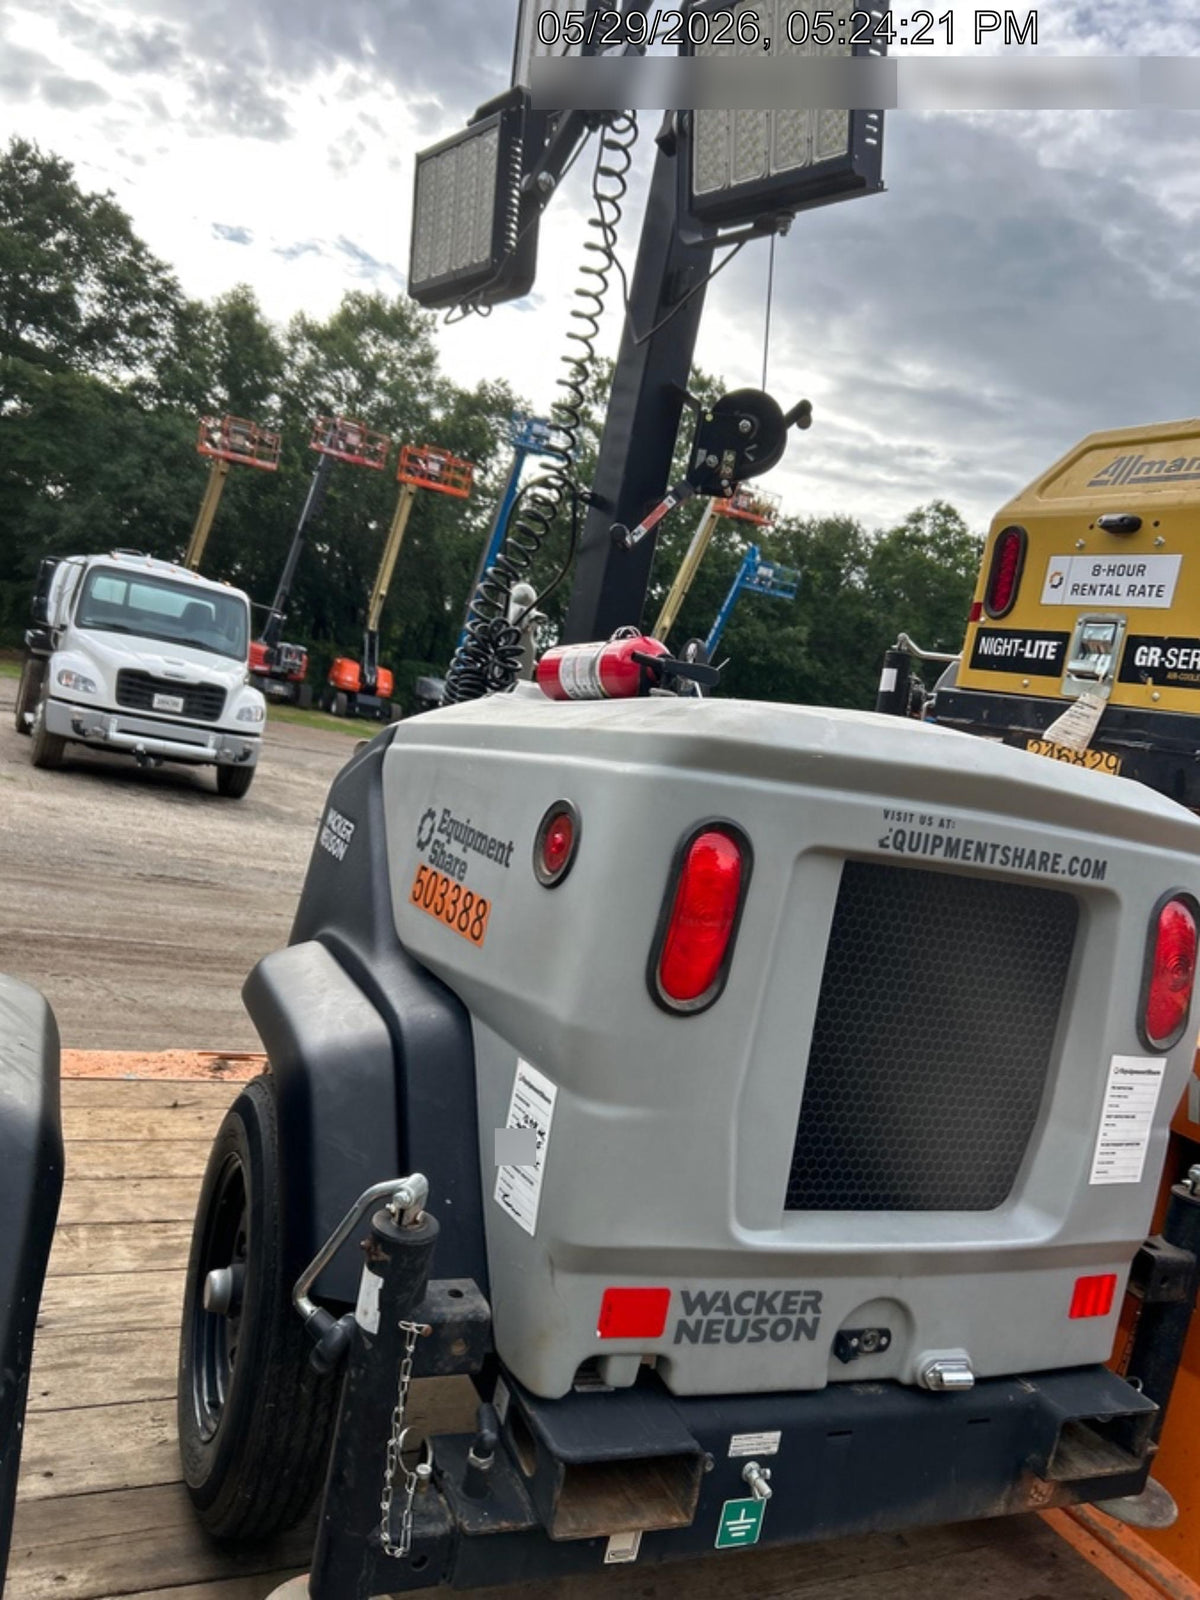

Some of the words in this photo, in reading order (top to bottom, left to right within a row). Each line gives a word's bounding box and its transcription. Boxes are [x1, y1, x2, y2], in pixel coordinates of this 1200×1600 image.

[1091, 563, 1147, 578] 8-HOUR
[1070, 583, 1122, 597] RENTAL
[1126, 584, 1166, 599] RATE
[978, 636, 1057, 660] NIGHT-LITE
[1134, 645, 1200, 669] GR-SER
[883, 809, 914, 823] VISIT
[919, 815, 933, 827] US
[938, 817, 956, 829] AT:
[437, 808, 514, 868] Equipment
[428, 839, 468, 882] Share
[412, 865, 488, 941] 503388
[680, 1290, 823, 1316] WACKER
[674, 1317, 820, 1344] NEUSON
